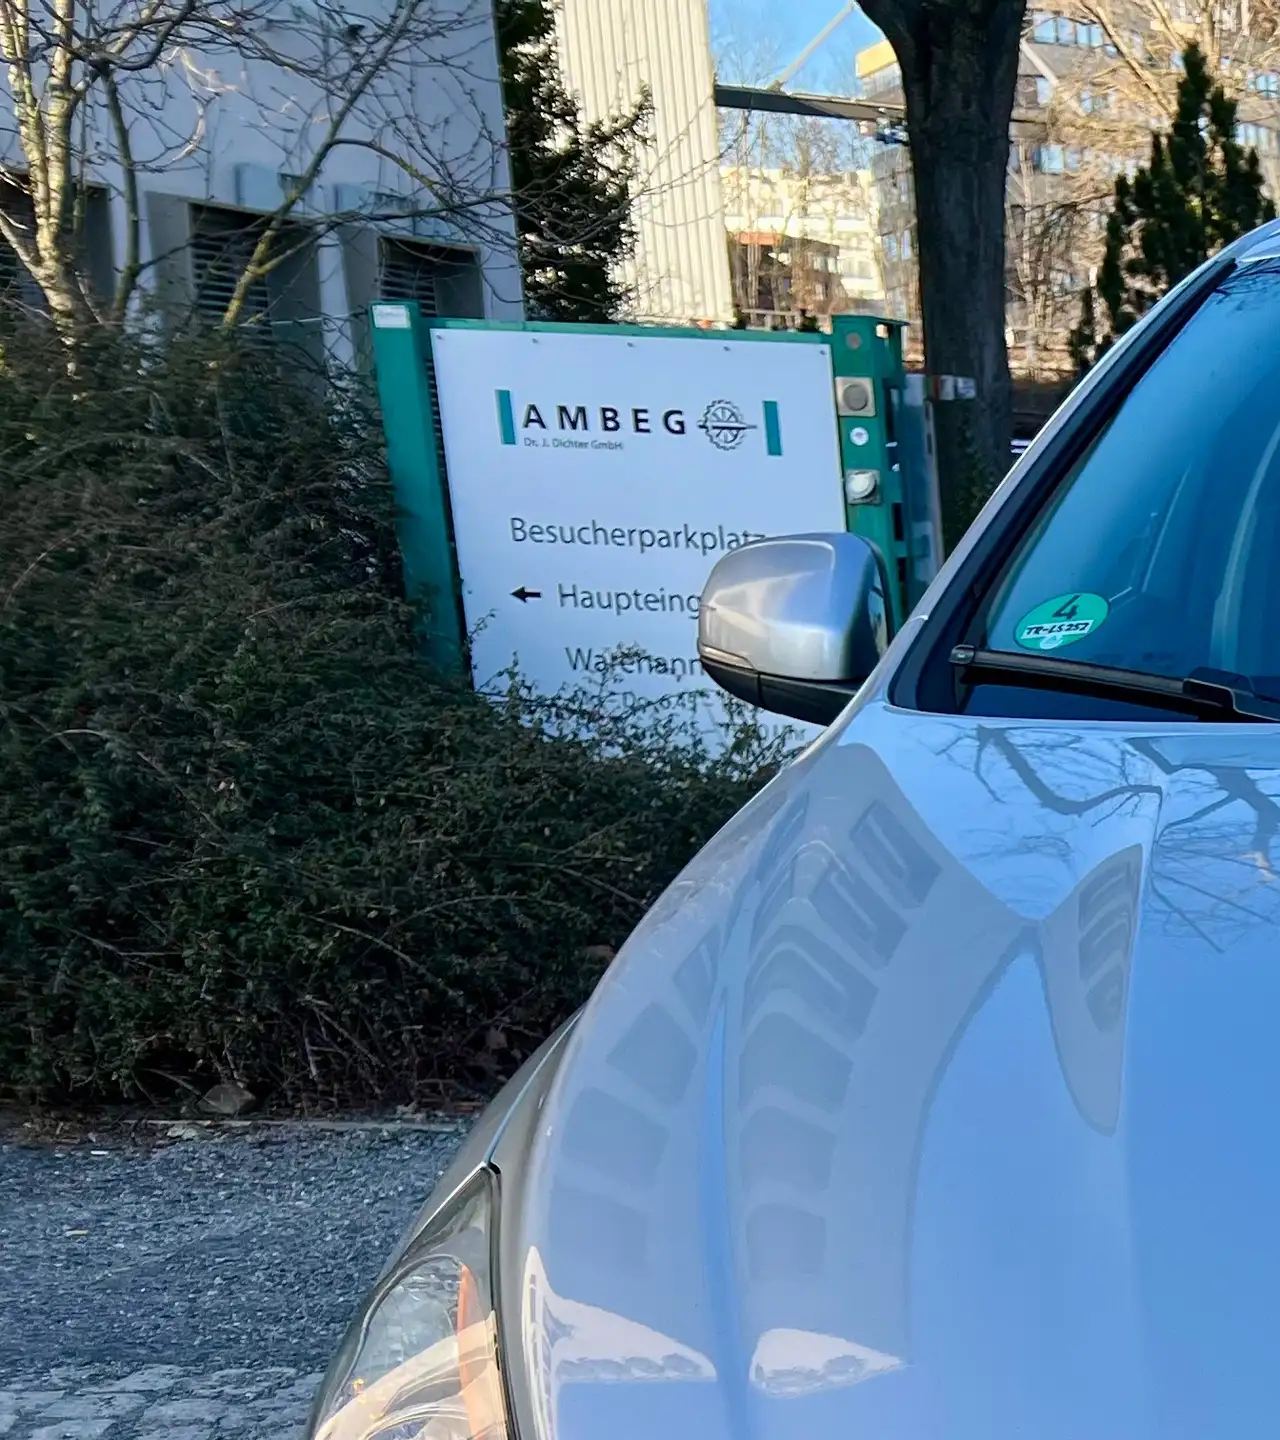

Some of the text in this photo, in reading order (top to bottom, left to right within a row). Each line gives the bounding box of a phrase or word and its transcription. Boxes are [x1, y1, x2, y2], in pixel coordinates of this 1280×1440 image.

[521, 403, 686, 435] AMBEG
[590, 440, 624, 450] GmbH
[1053, 595, 1081, 620] 4
